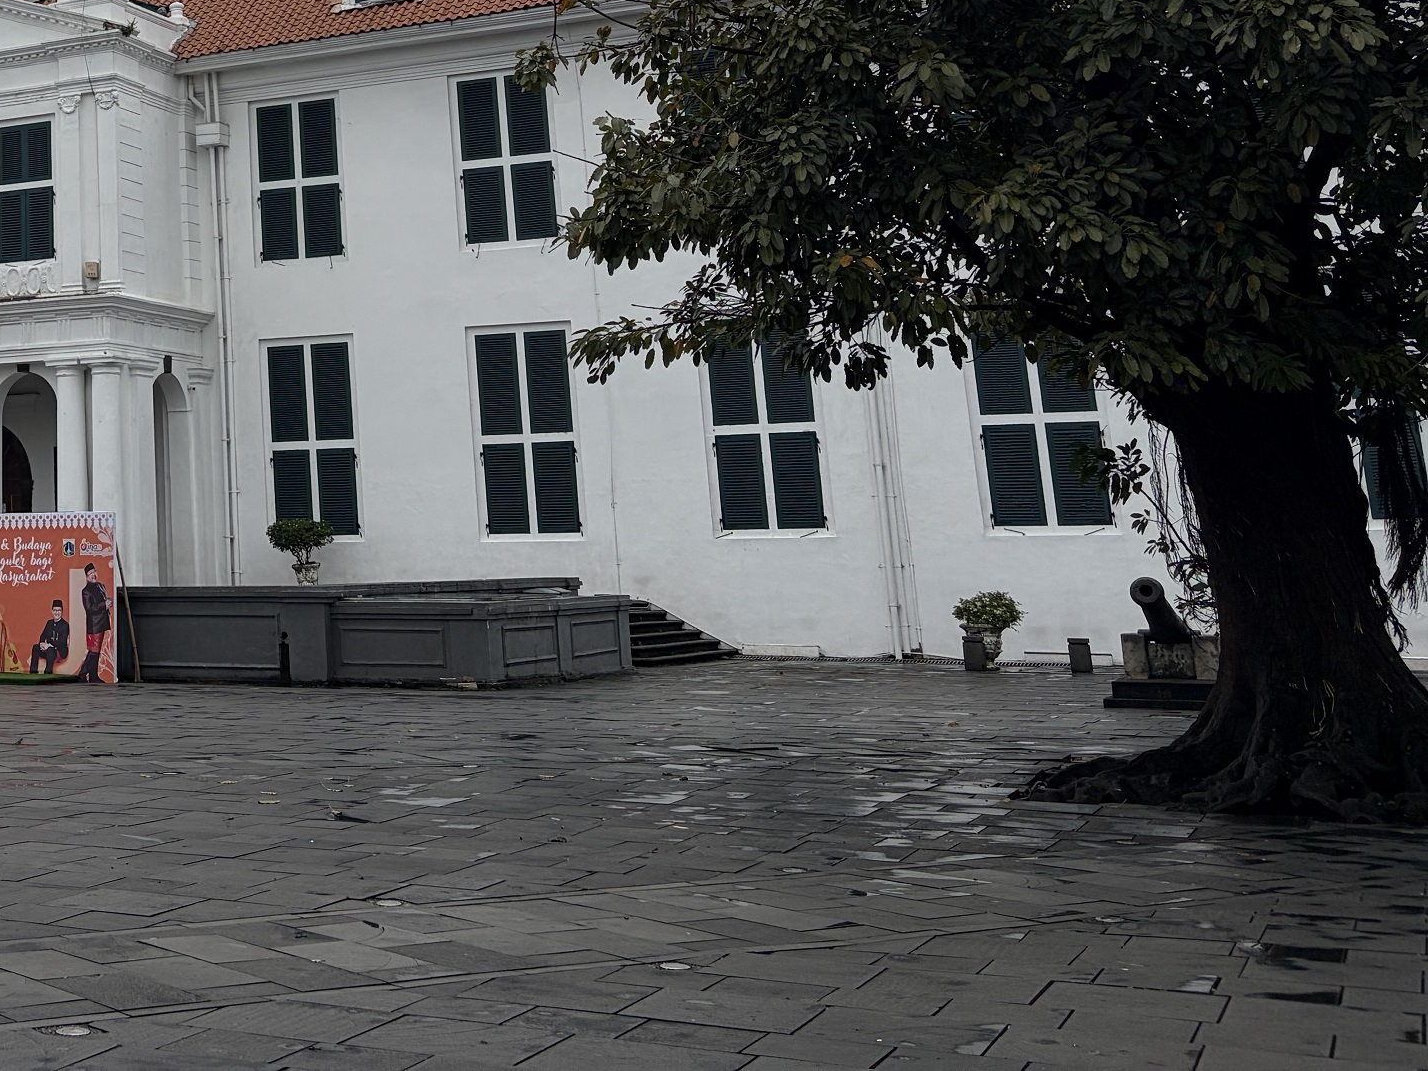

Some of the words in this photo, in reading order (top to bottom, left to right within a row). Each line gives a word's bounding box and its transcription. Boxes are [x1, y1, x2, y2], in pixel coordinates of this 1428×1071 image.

[0, 538, 10, 551] &
[13, 536, 53, 555] Budaya
[30, 552, 53, 570] bagi
